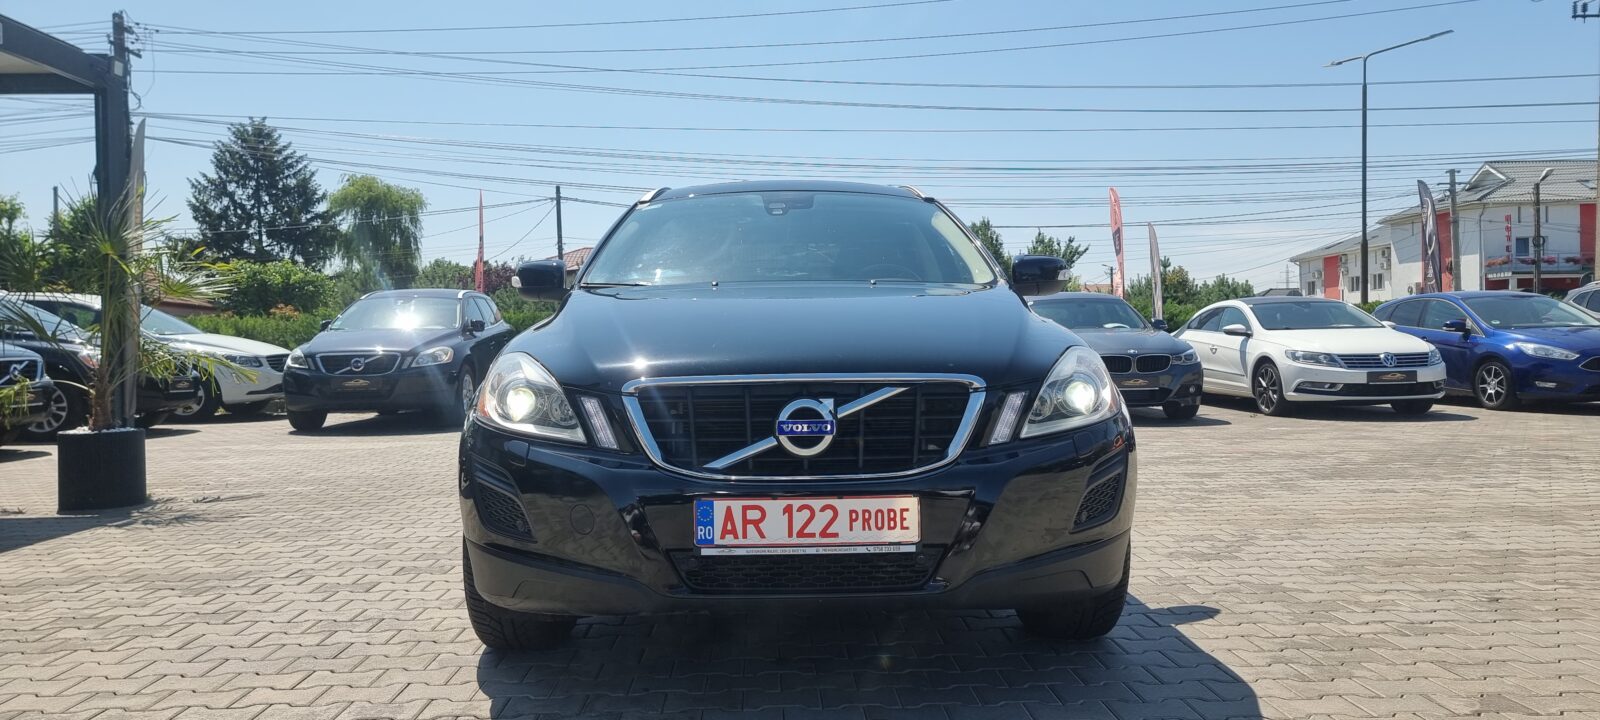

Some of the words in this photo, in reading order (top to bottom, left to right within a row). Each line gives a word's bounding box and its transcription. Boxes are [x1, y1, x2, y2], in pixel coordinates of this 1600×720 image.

[780, 423, 831, 432] VOLVO
[720, 504, 767, 540] AR
[783, 503, 839, 539] 122
[849, 508, 910, 532] PROBE
[697, 525, 713, 540] RO
